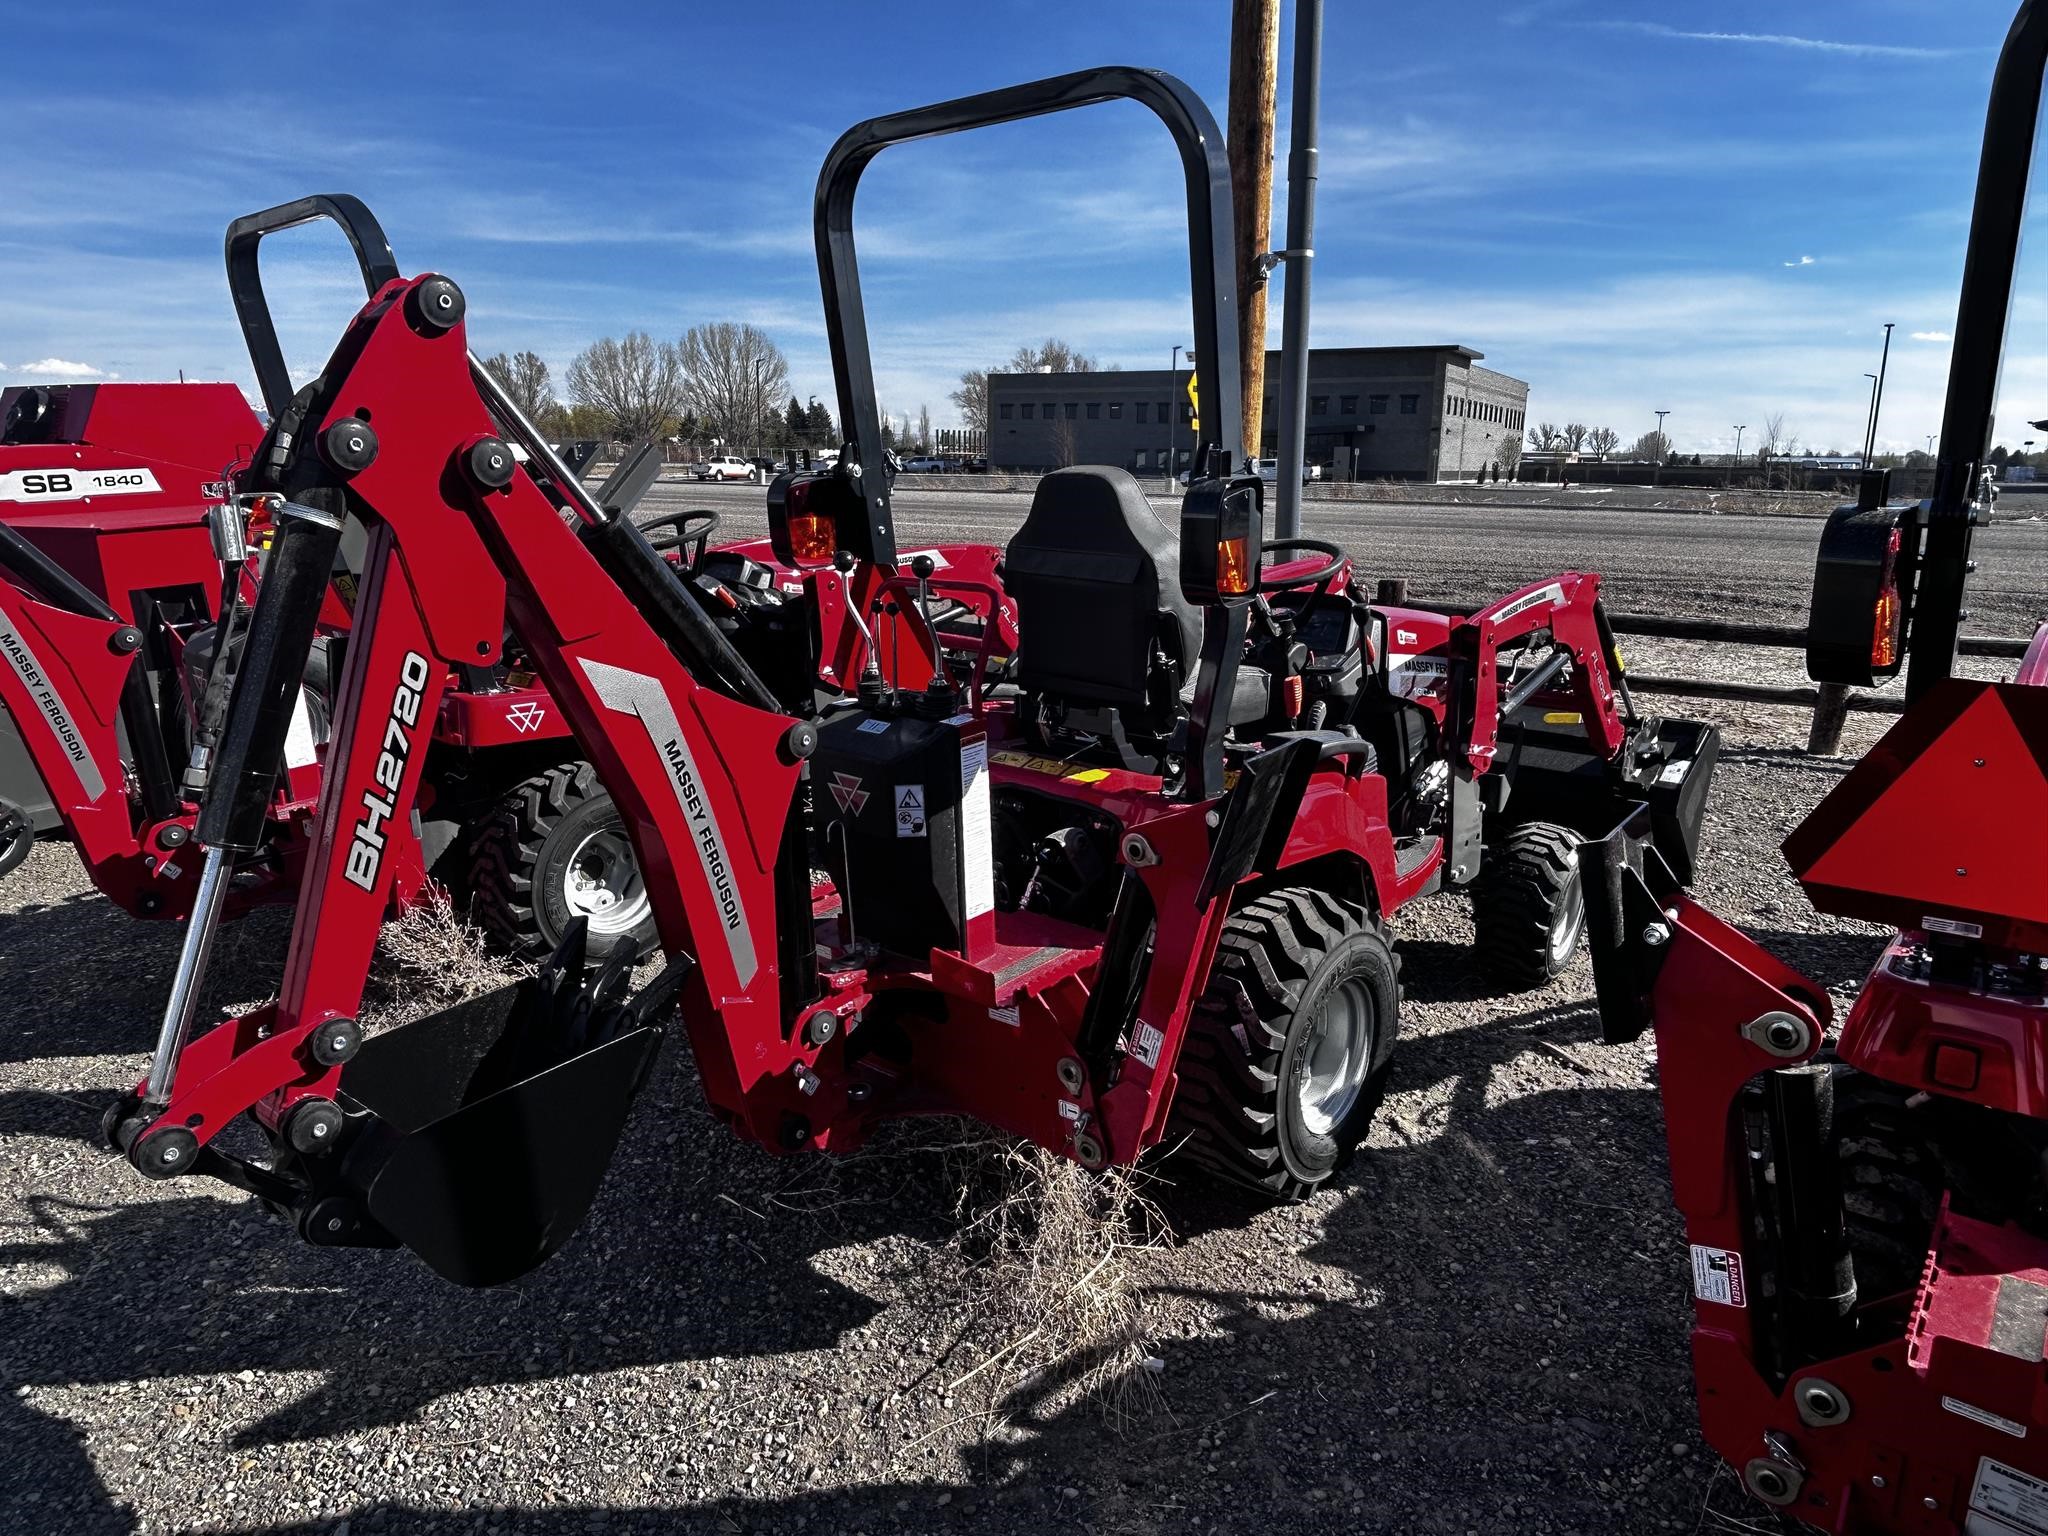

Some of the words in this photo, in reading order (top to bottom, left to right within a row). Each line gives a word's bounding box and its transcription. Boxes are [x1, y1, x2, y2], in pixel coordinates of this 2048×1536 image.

[22, 474, 72, 494] SB
[93, 475, 143, 488] 1840
[0, 633, 44, 688] MASSEY
[39, 691, 85, 762] FERGUSON
[1404, 660, 1433, 673] MASSEY
[344, 651, 430, 893] BH.2720
[664, 739, 706, 822] MASSEY
[699, 825, 740, 930] FERGUSON
[1729, 1266, 1741, 1302] DANGER
